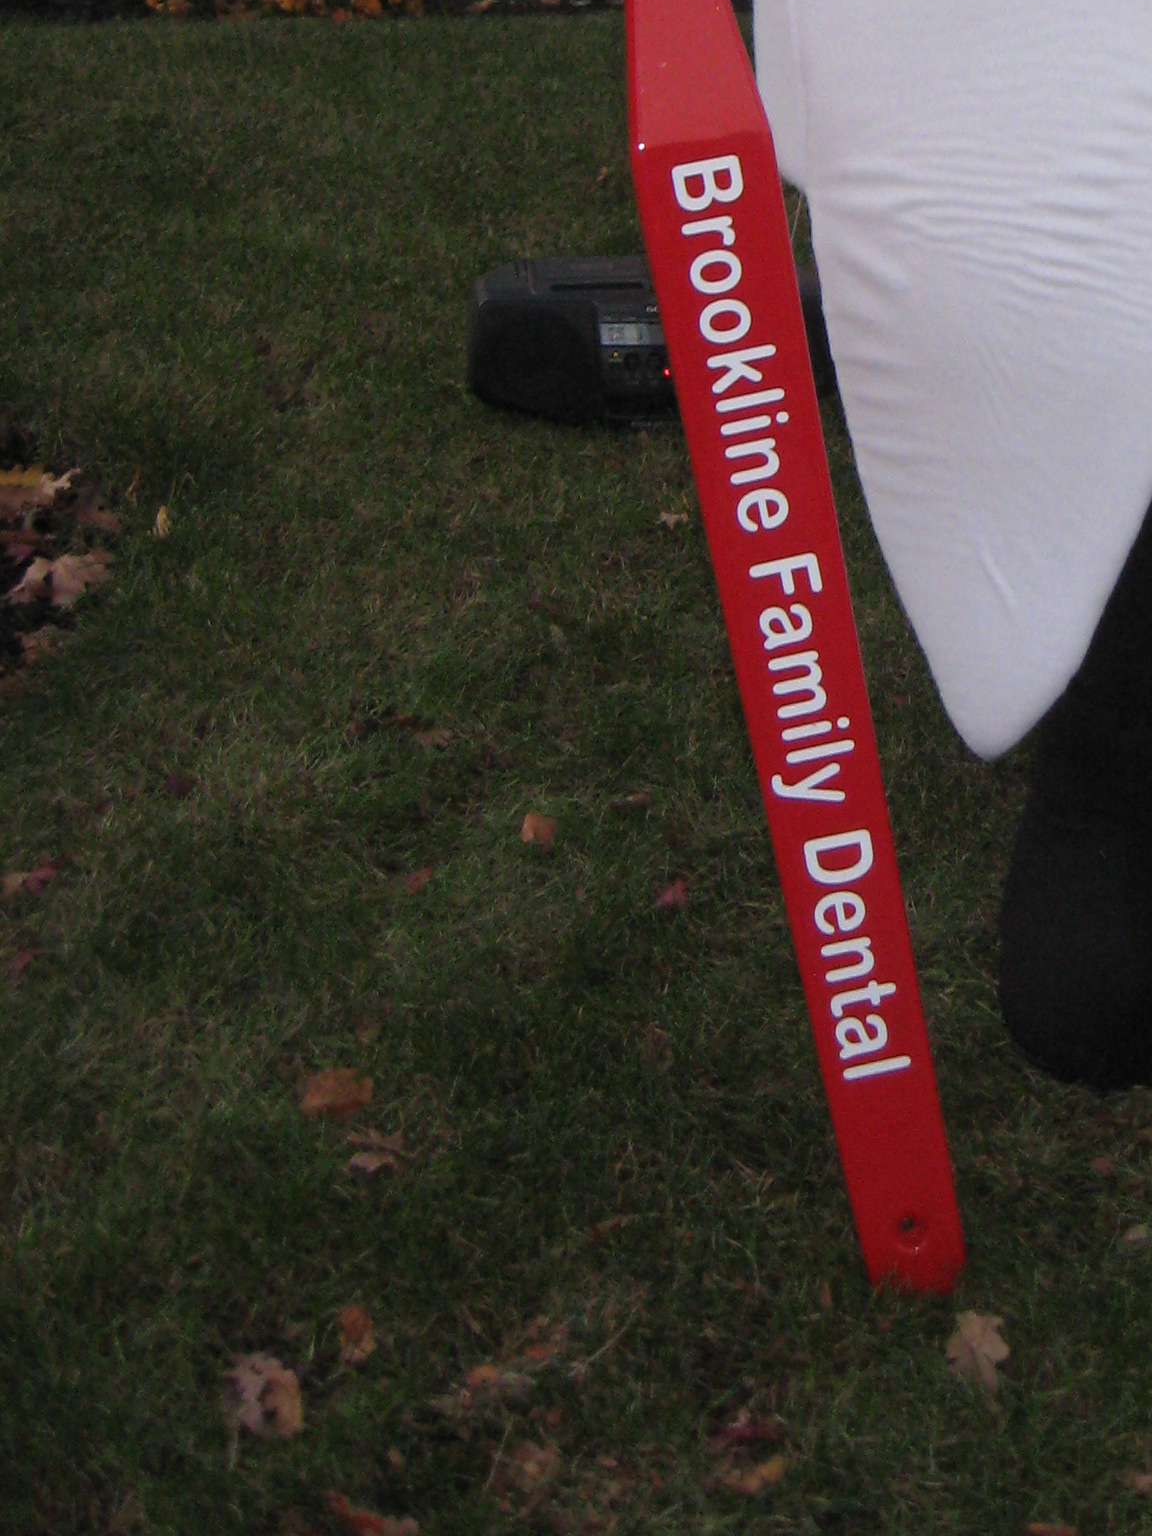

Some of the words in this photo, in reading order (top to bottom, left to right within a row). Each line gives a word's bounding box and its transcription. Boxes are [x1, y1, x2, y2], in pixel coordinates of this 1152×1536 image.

[671, 154, 790, 533] Brookline
[748, 552, 856, 803] Family
[803, 828, 912, 1081] Dental
